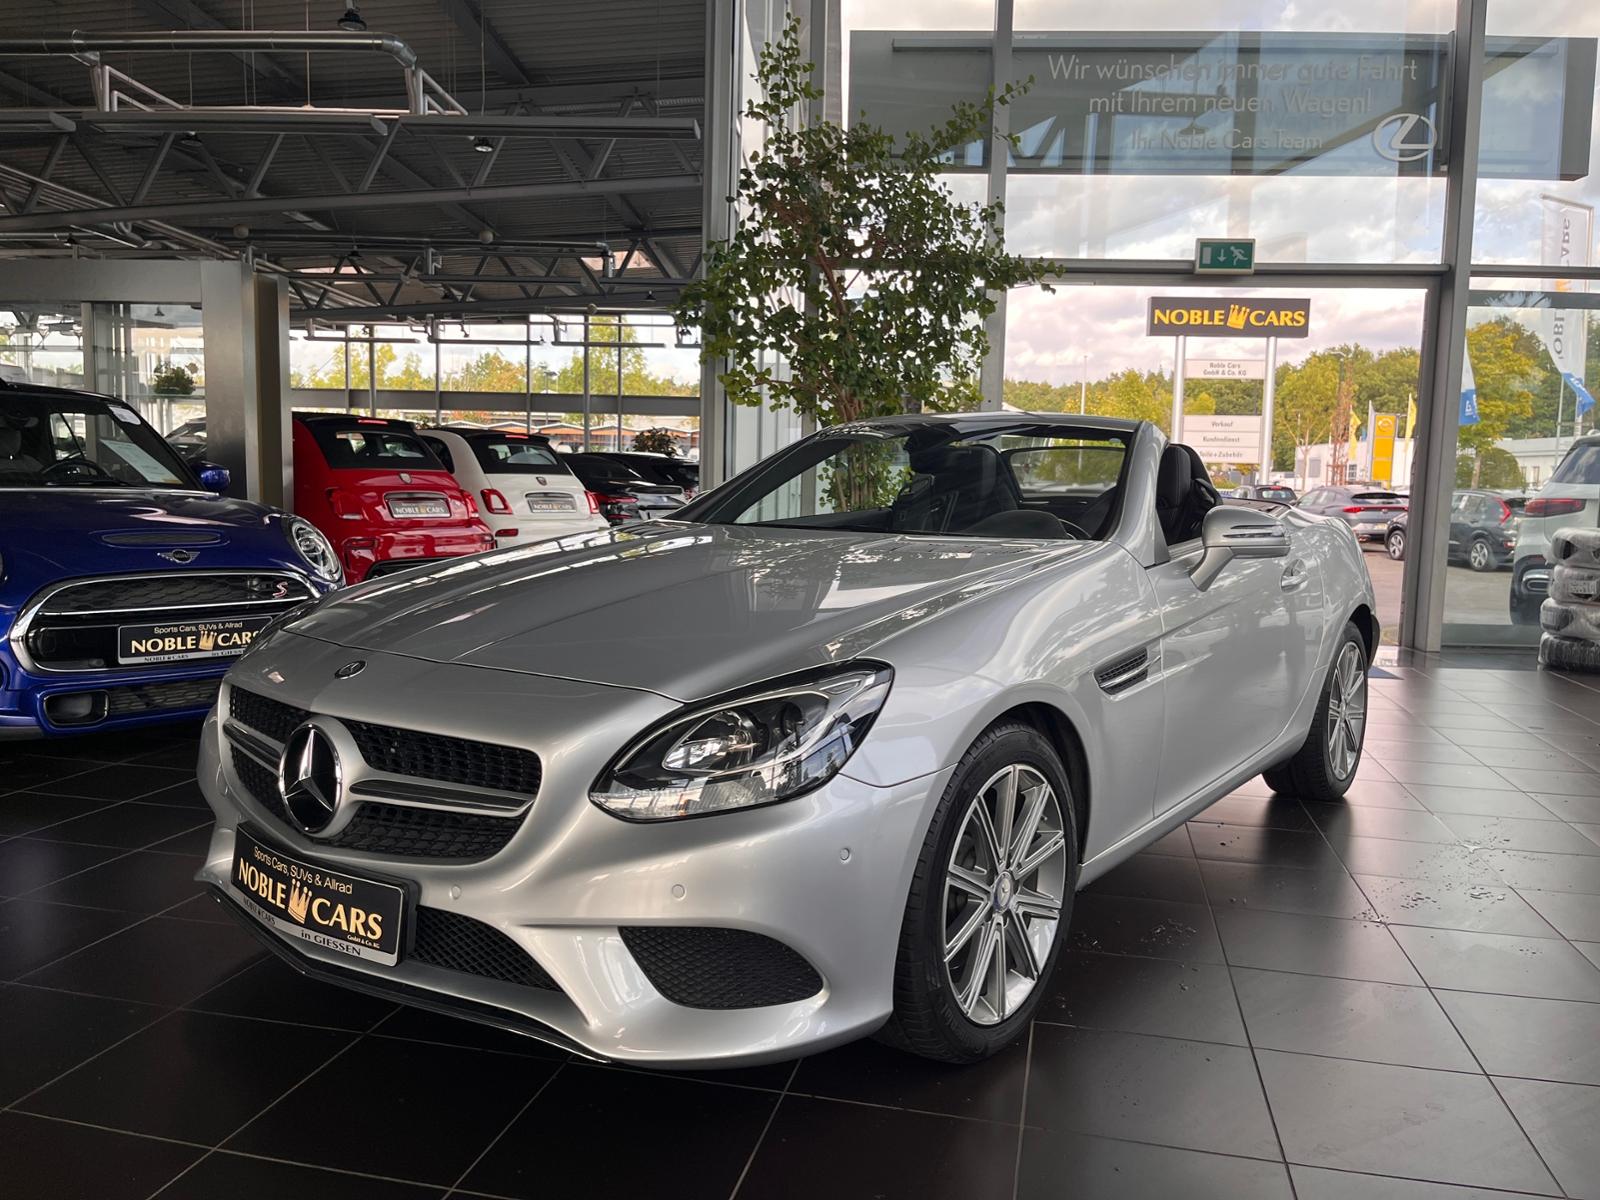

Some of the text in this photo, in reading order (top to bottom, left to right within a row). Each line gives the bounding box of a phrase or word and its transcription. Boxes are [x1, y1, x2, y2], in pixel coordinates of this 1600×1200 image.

[1048, 54, 1418, 85] Wir wünschen immer gute Fahrt
[1089, 87, 1372, 118] mit Ihrem neuen Wagen!
[1132, 127, 1323, 150] Ihr Noble Cars Team
[1154, 309, 1305, 327] NOBLE CARS
[1203, 369, 1220, 377] GmbH
[1227, 362, 1241, 370] Cars
[395, 506, 419, 514] NOBLE
[154, 626, 178, 634] Sports
[198, 623, 217, 631] SUVs
[224, 621, 243, 629] Allrad
[131, 635, 196, 654] NOBLE
[254, 845, 353, 895] Sports Cars, SUVs & Allrad
[238, 857, 383, 941] NOBLE CARS
[301, 929, 361, 956] in GIESSEN
